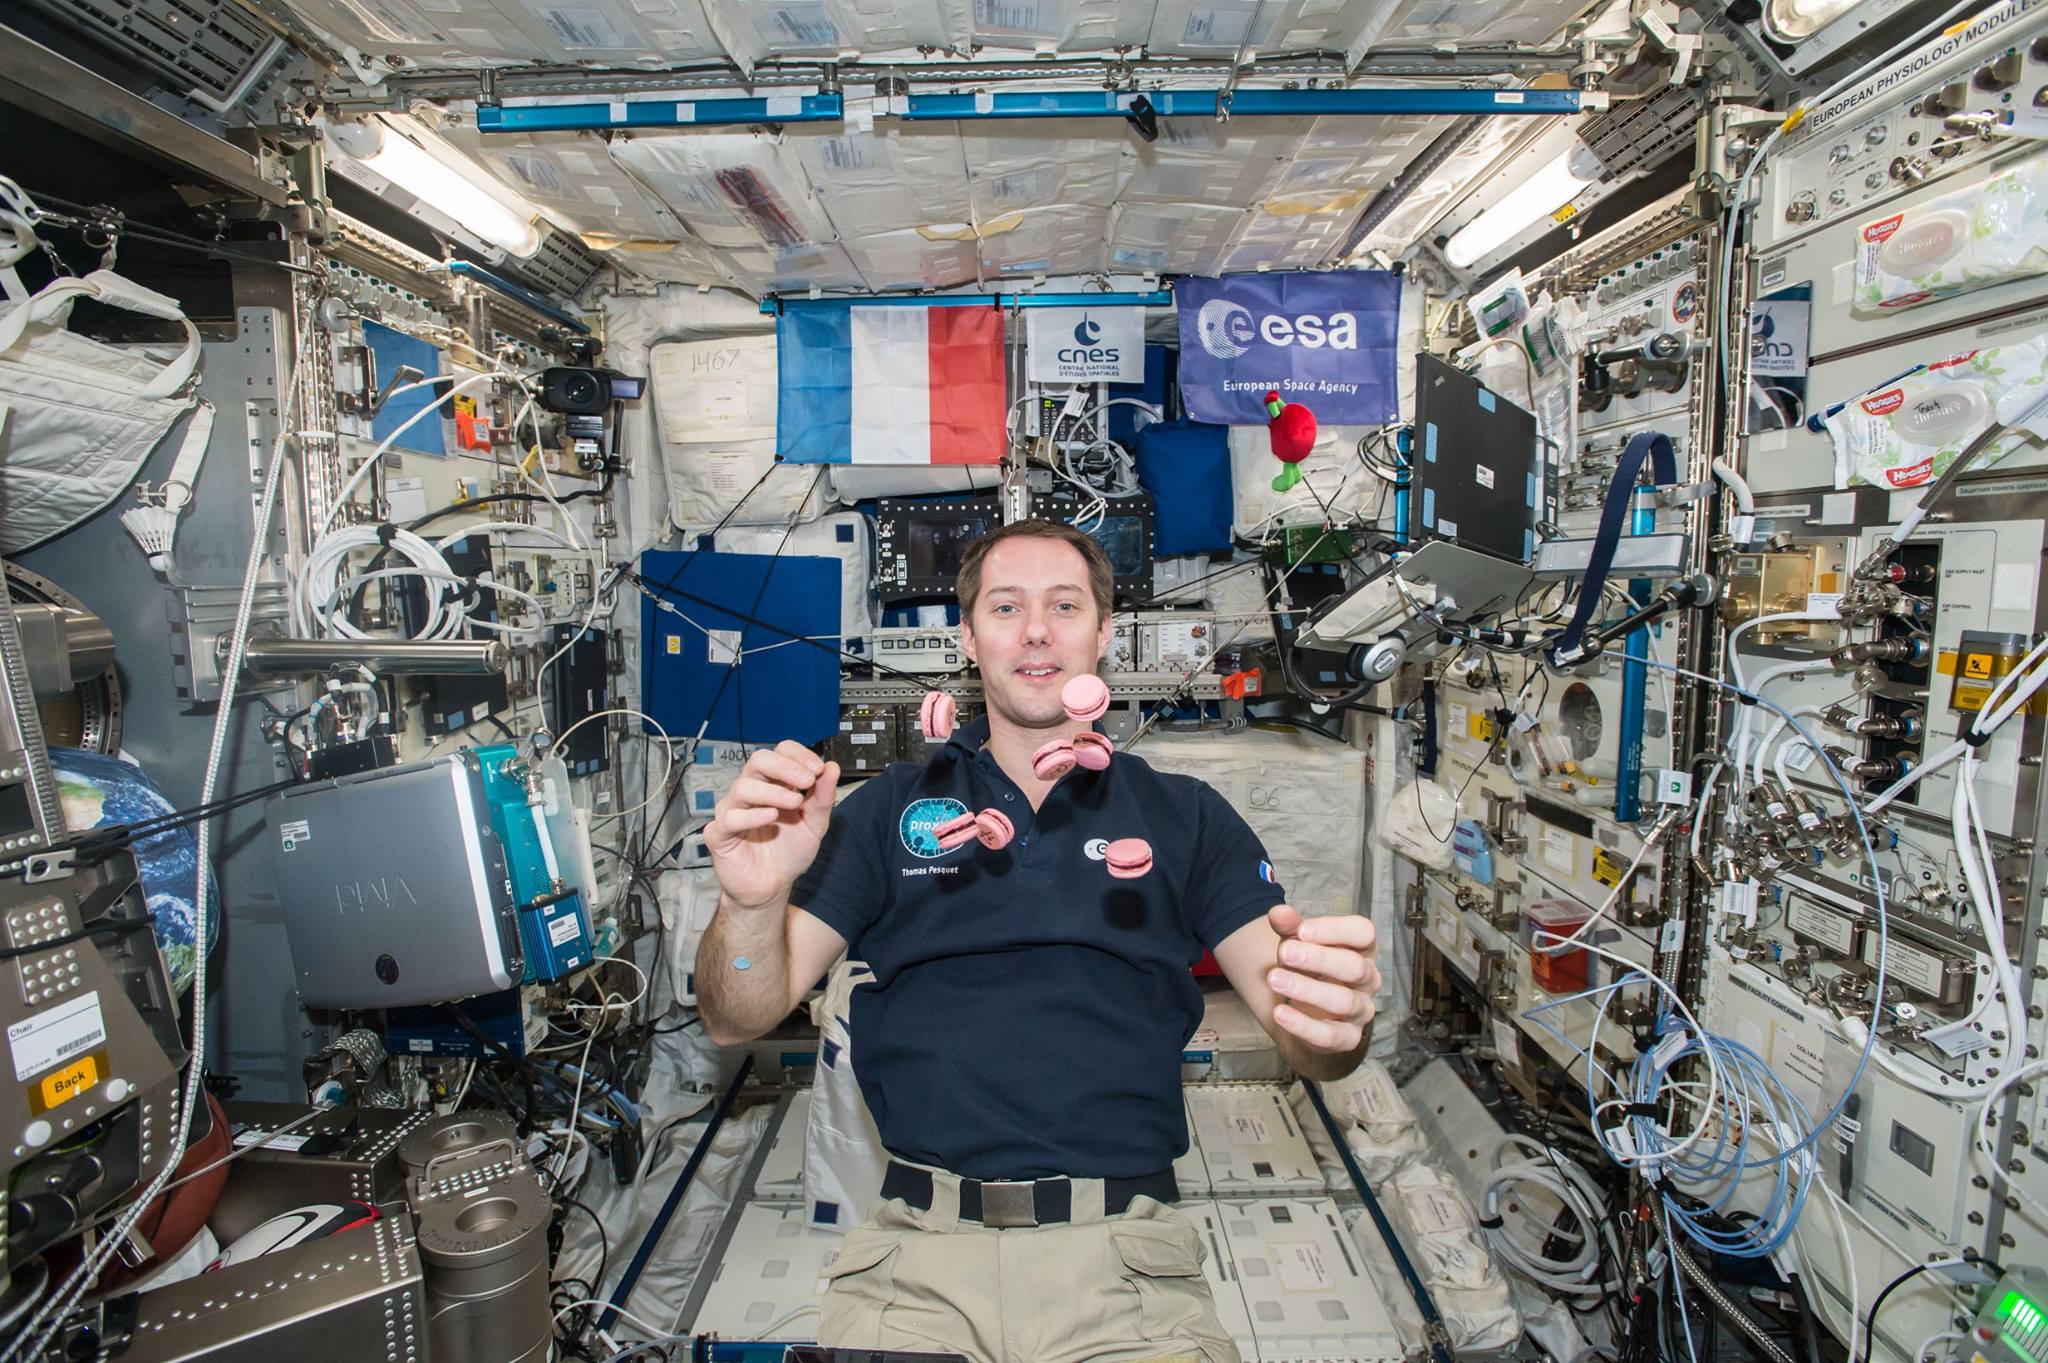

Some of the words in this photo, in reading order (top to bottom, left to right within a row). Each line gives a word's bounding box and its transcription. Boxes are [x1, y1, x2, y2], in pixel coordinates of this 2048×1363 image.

[1812, 83, 1874, 128] EUROPEAN
[1876, 32, 1963, 93] PHYSIOLOGY
[1260, 312, 1358, 350] esa
[691, 348, 741, 373] 1467
[1057, 347, 1121, 363] cnes
[1223, 379, 1280, 393] European
[1283, 378, 1316, 393] Space
[1318, 380, 1358, 395] Agency
[1866, 393, 1902, 411] HUGGIES
[1892, 463, 1932, 482] HUGGIES
[901, 867, 928, 877] Thomas
[928, 865, 959, 877] Pesquet
[9, 1023, 34, 1038] Chair
[54, 1070, 87, 1094] Back
